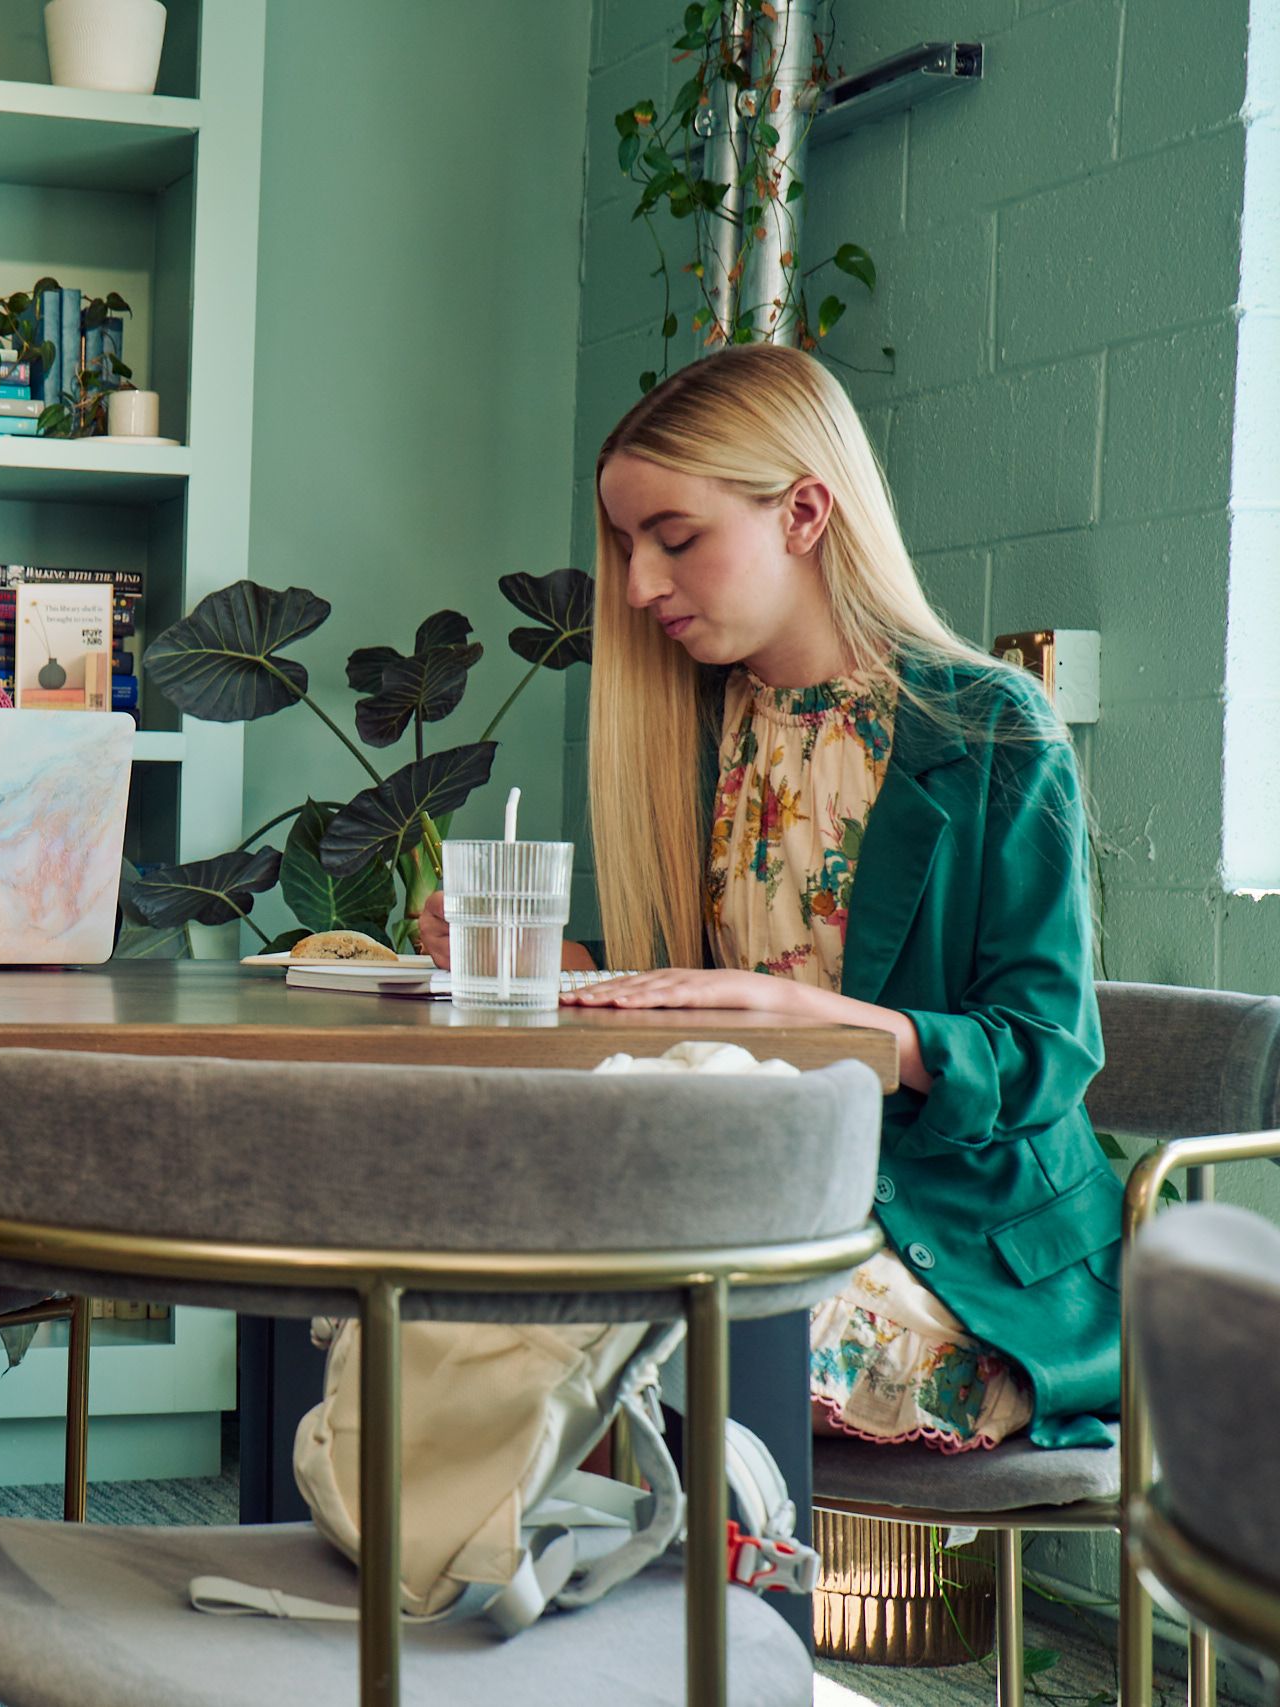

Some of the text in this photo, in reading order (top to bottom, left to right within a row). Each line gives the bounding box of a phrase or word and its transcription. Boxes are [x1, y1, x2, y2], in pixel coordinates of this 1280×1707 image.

[26, 567, 141, 583] WALKING WITH THE WIND
